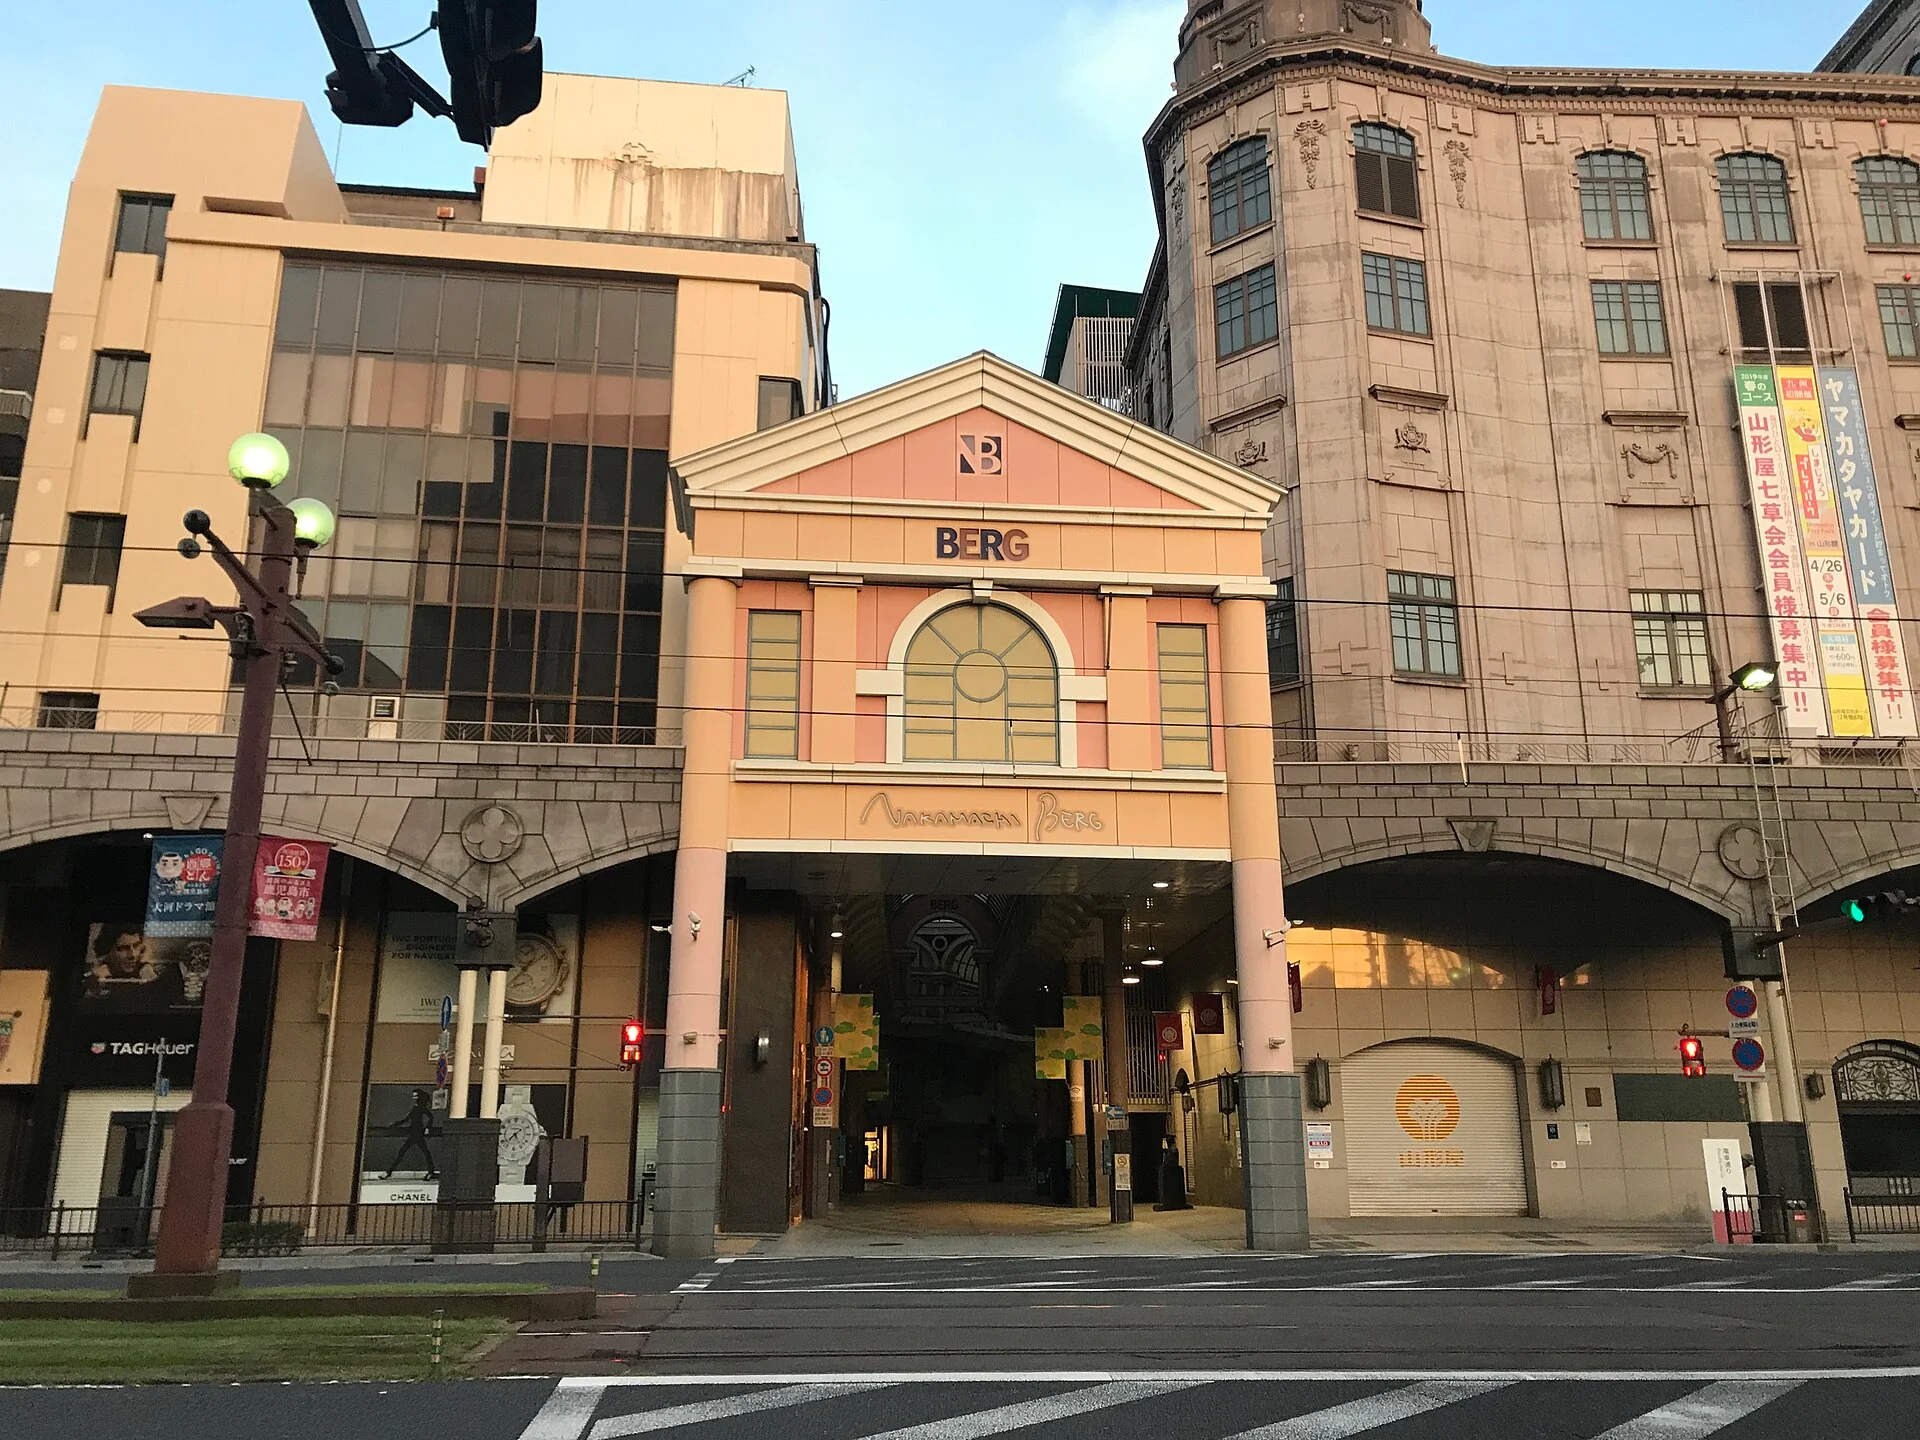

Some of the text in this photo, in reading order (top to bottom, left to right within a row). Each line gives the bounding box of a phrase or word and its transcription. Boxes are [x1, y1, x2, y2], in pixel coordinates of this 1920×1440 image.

[1743, 380, 1767, 392] 春の
[1742, 392, 1774, 402] コース
[1826, 377, 1877, 595] ヤマカタヤカード
[936, 527, 1030, 562] BERG
[1811, 559, 1843, 573] 4/26
[1820, 592, 1846, 606] 5/6
[263, 884, 310, 897] 鹿児島市
[420, 998, 440, 1007] IWC
[389, 1193, 432, 1201] CHANEL
